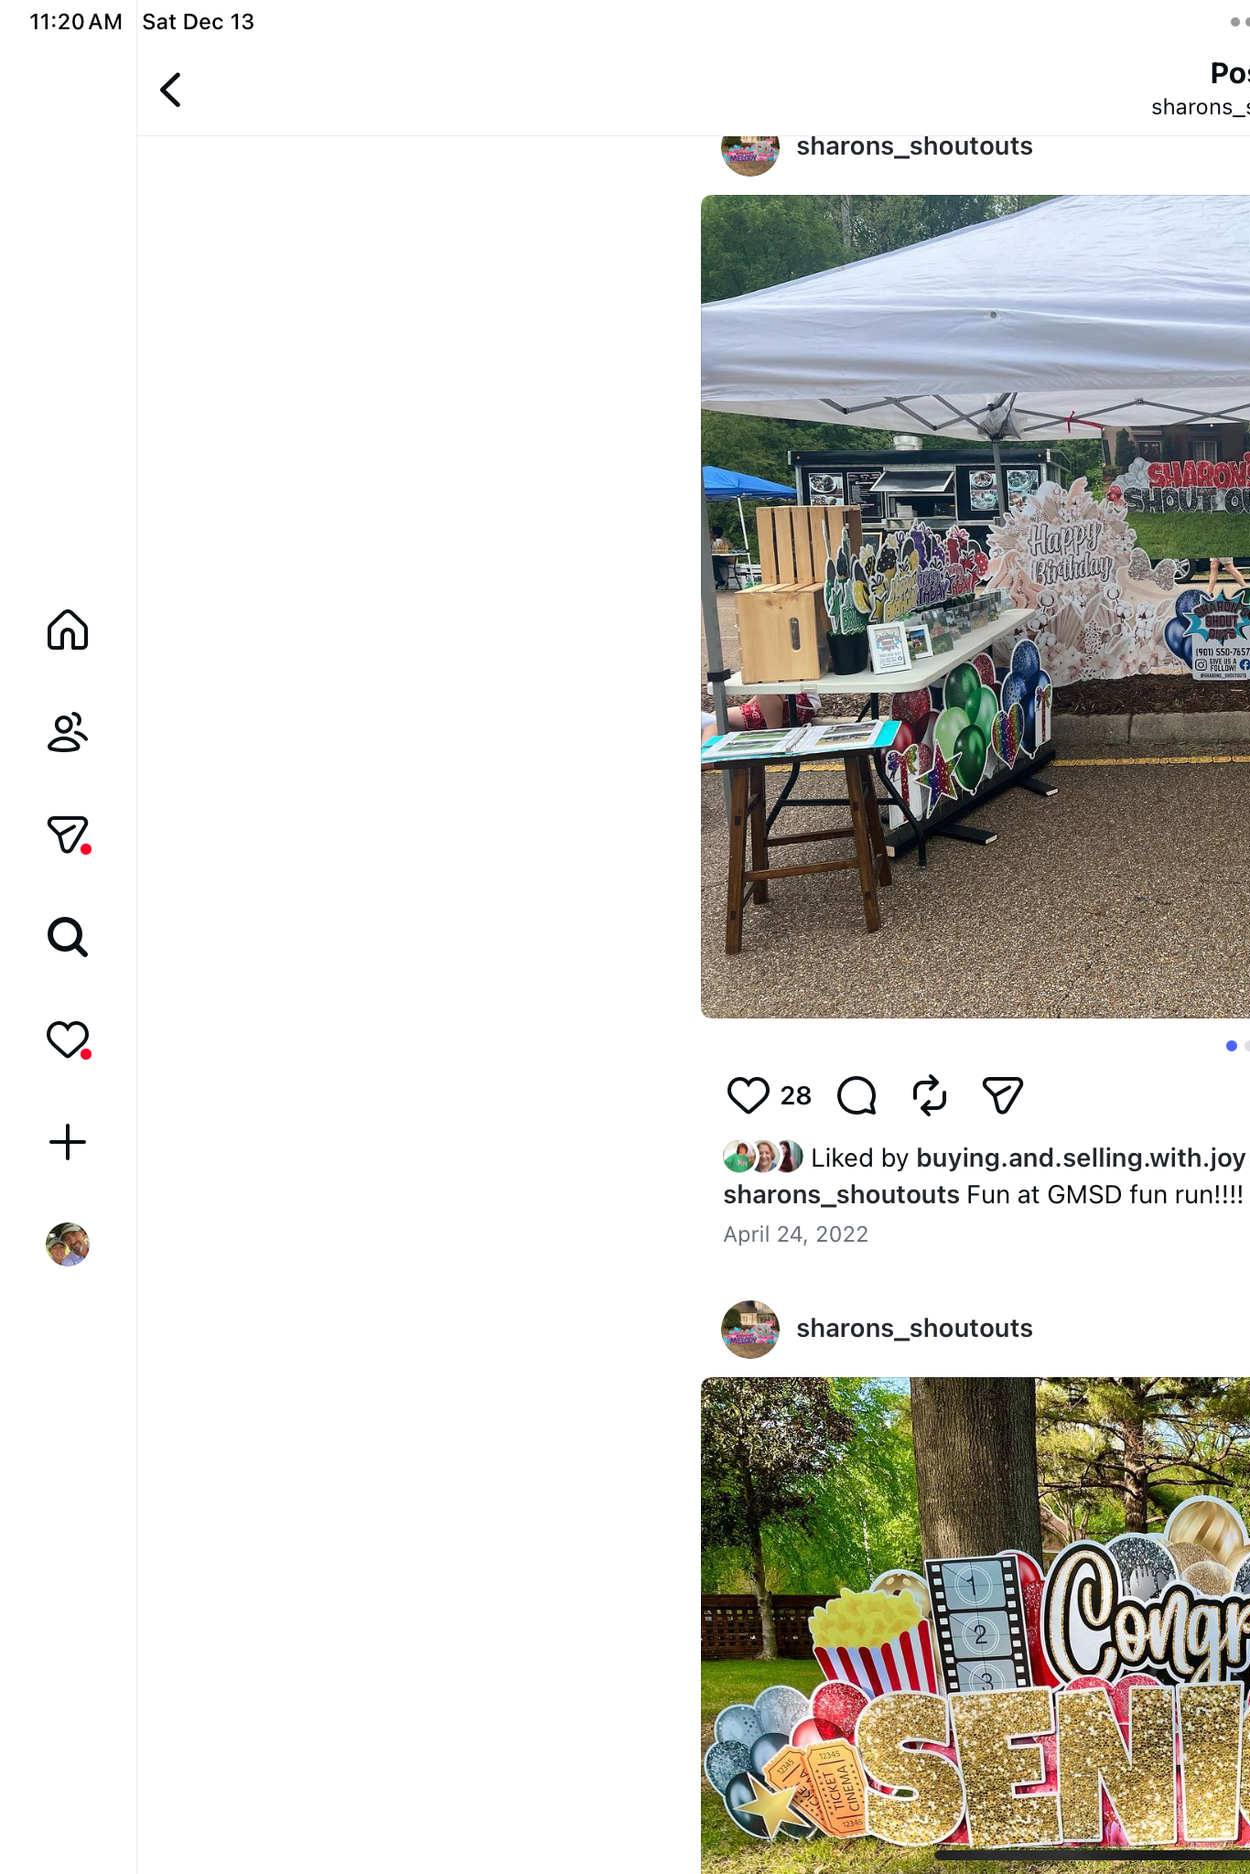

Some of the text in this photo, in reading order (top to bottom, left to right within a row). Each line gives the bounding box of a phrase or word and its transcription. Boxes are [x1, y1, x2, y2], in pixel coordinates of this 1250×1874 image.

[30, 13, 122, 30] 11:20 AM
[142, 13, 255, 31] Sat Dec 13
[796, 136, 1033, 160] sharons_shoutouts
[1124, 486, 1218, 514] SHOUT
[1028, 519, 1102, 556] Happy
[1031, 555, 1113, 586] Birthday
[1205, 615, 1239, 628] SHOUT
[1208, 629, 1237, 640] OUTS
[1196, 648, 1250, 657] (901) 550-7657
[780, 1085, 812, 1106] 28
[812, 1146, 873, 1168] Liked
[882, 1147, 910, 1173] by
[917, 1146, 1247, 1173] buying.and.selling.with.joy
[723, 1183, 1243, 1209] sharons_shoutouts Fun at GMSD fun run!!!!
[723, 1224, 868, 1247] April 24, 2022
[796, 1317, 1033, 1342] sharons_shoutouts
[966, 1575, 977, 1596] 1
[974, 1624, 987, 1644] 2
[982, 1672, 993, 1691] 3
[819, 1750, 841, 1760] 12345
[777, 1758, 795, 1775] 12345
[823, 1771, 845, 1811] TICKET
[837, 1764, 860, 1812] CINEMA
[843, 1819, 864, 1828] 12345
